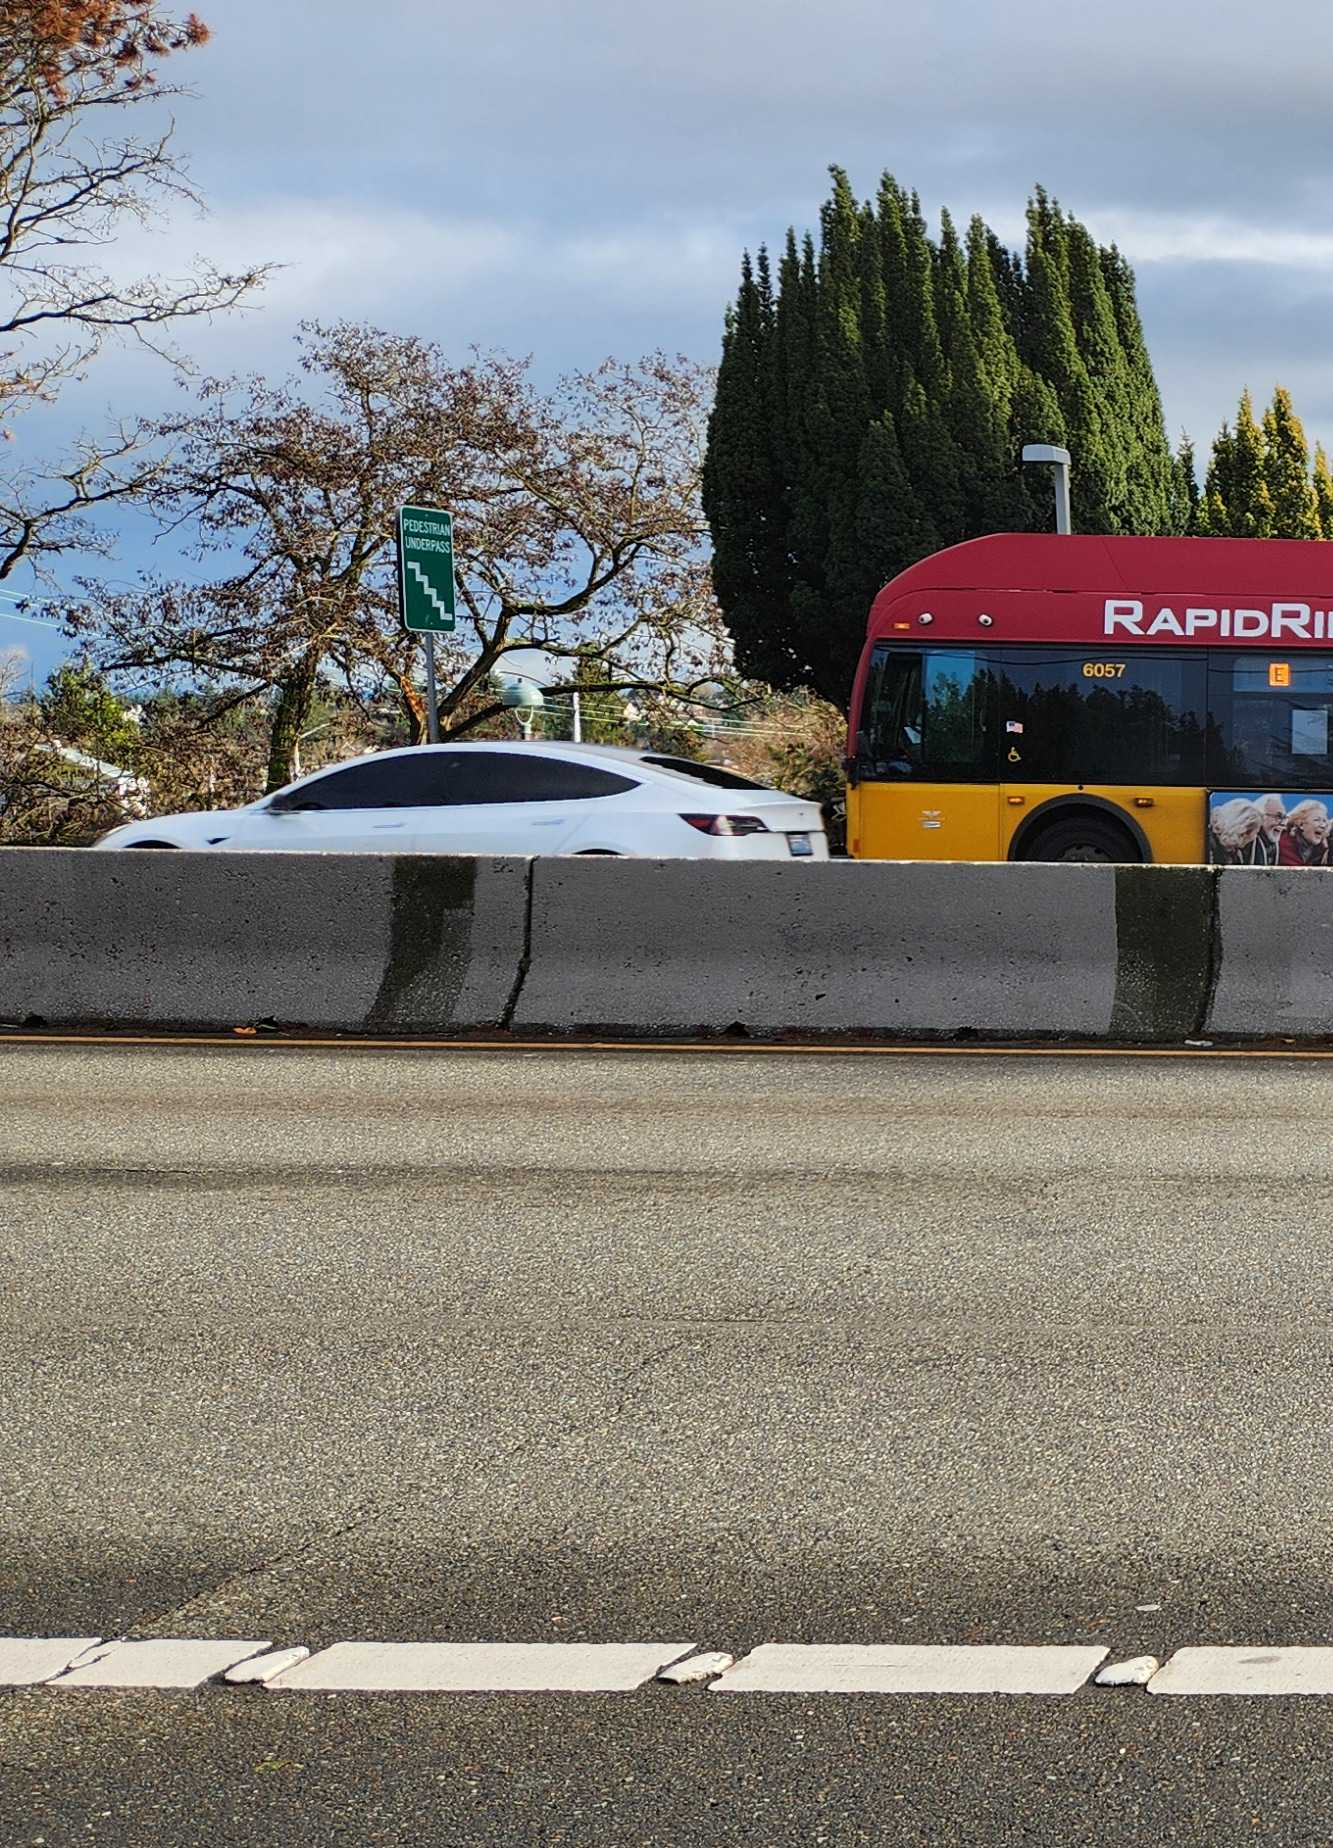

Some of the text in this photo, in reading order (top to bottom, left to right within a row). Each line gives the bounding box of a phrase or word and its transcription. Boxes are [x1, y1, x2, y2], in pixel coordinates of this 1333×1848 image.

[403, 518, 450, 536] PEDESTRIAN
[404, 536, 450, 553] UNDERPASS
[1082, 663, 1126, 678] 6057
[1274, 667, 1285, 682] E
